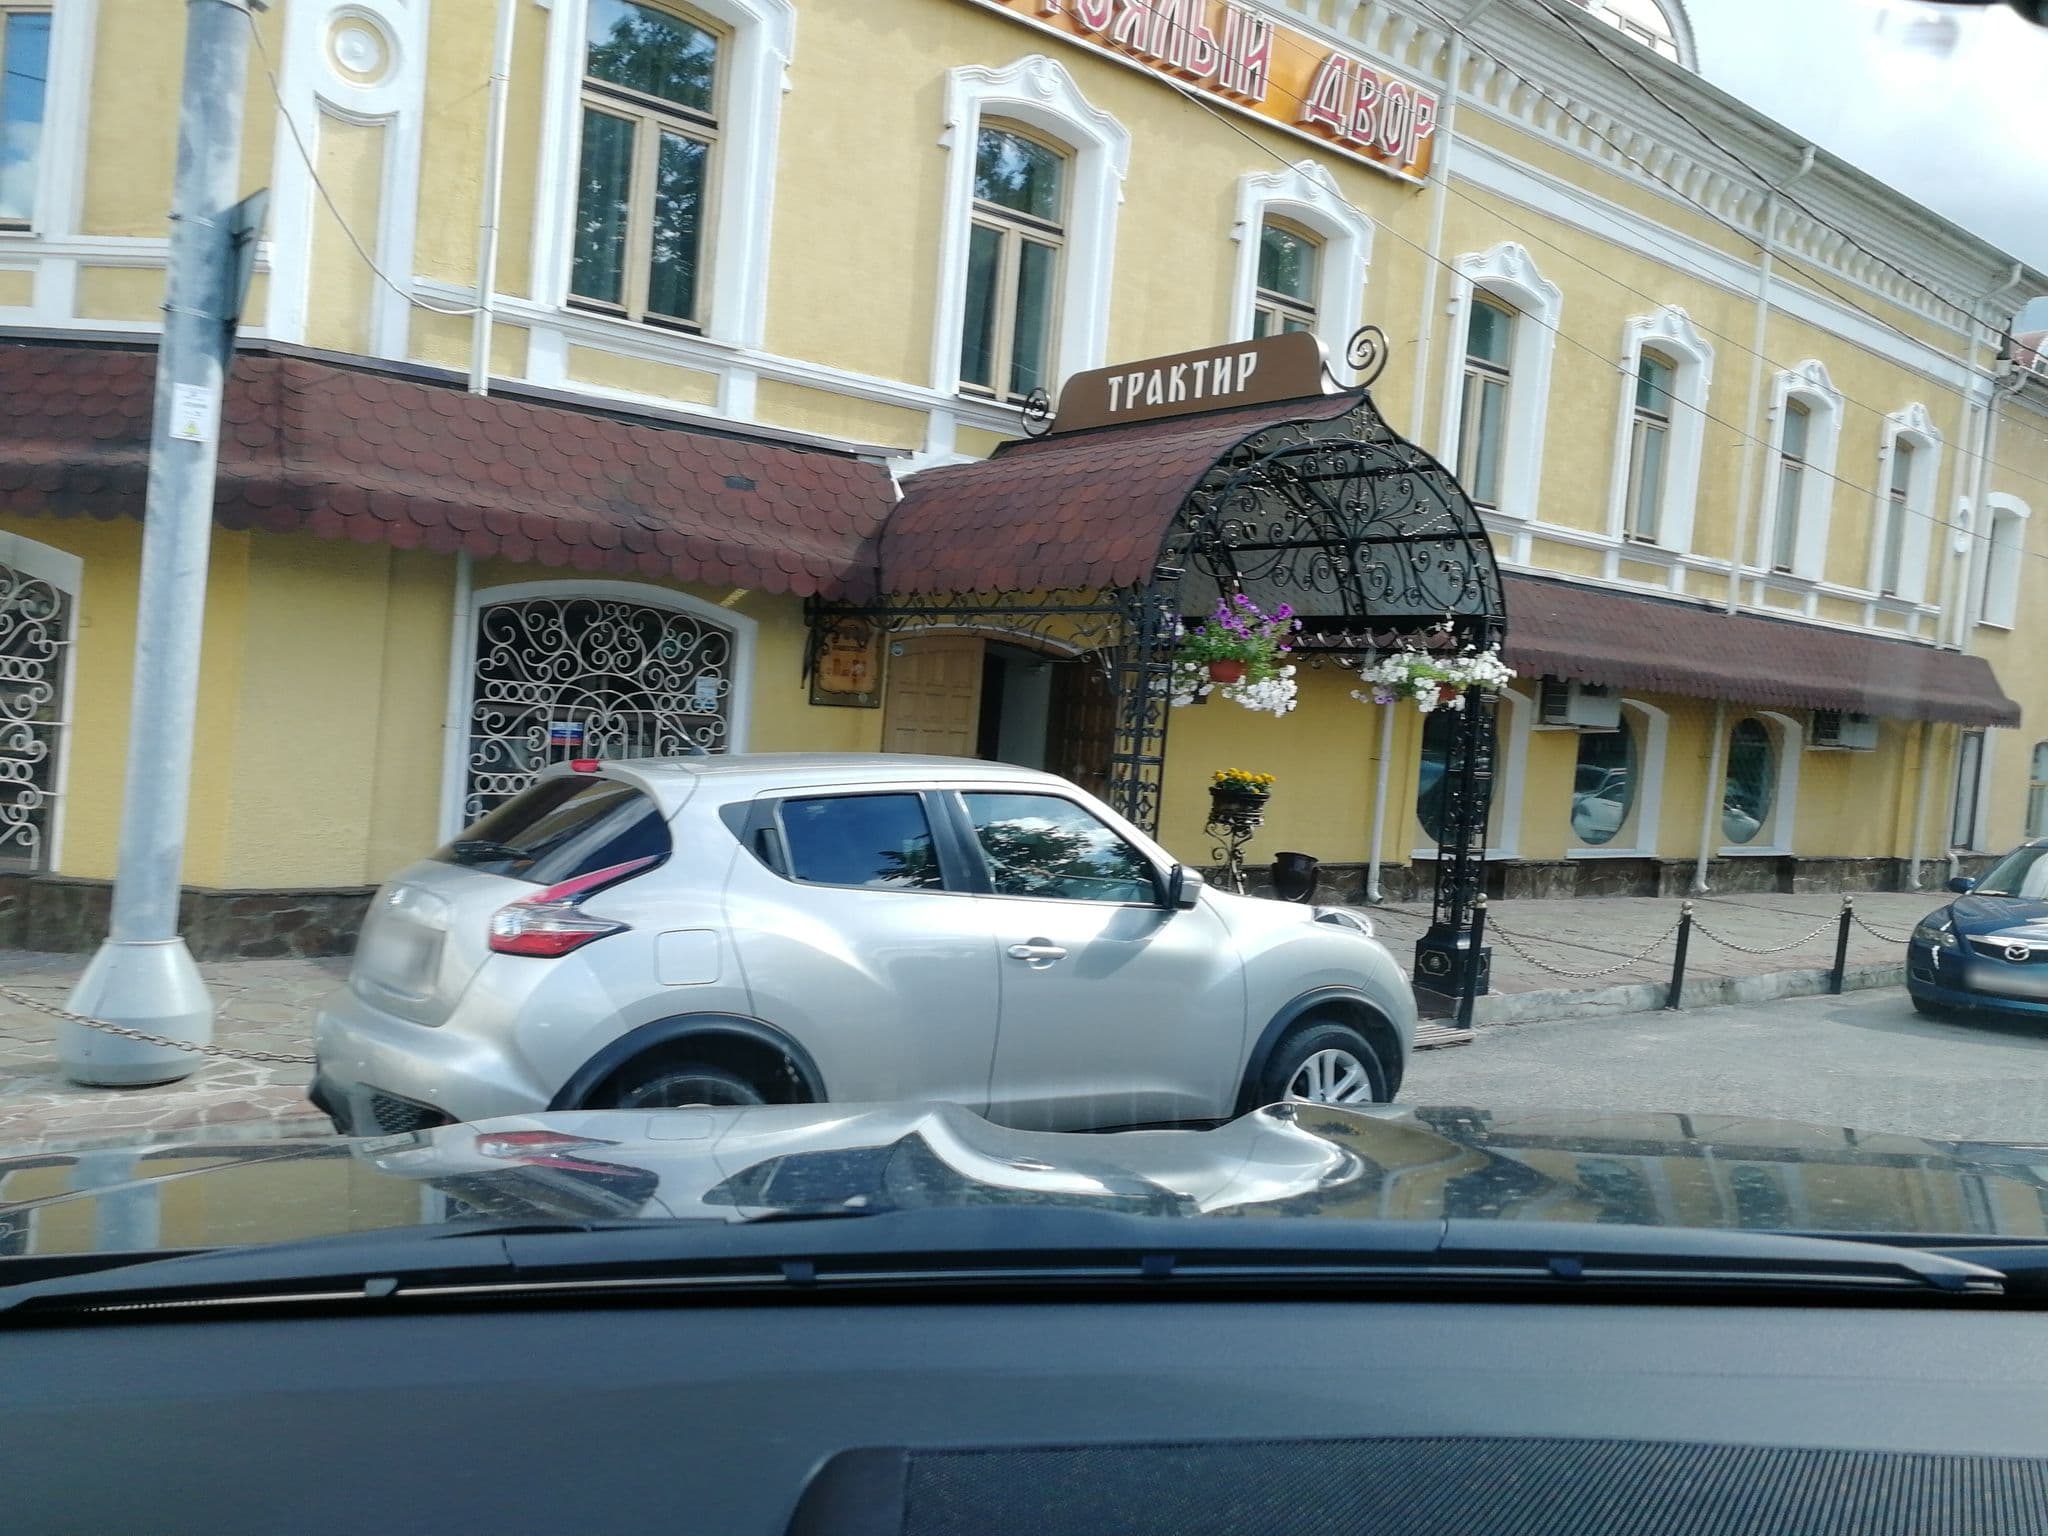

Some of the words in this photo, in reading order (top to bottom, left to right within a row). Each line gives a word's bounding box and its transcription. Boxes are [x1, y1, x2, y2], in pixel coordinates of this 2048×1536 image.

[1045, 0, 1275, 102] ЯЛЫЙ
[1304, 52, 1440, 165] ДВОР
[1107, 351, 1258, 412] ТРАКТИР
